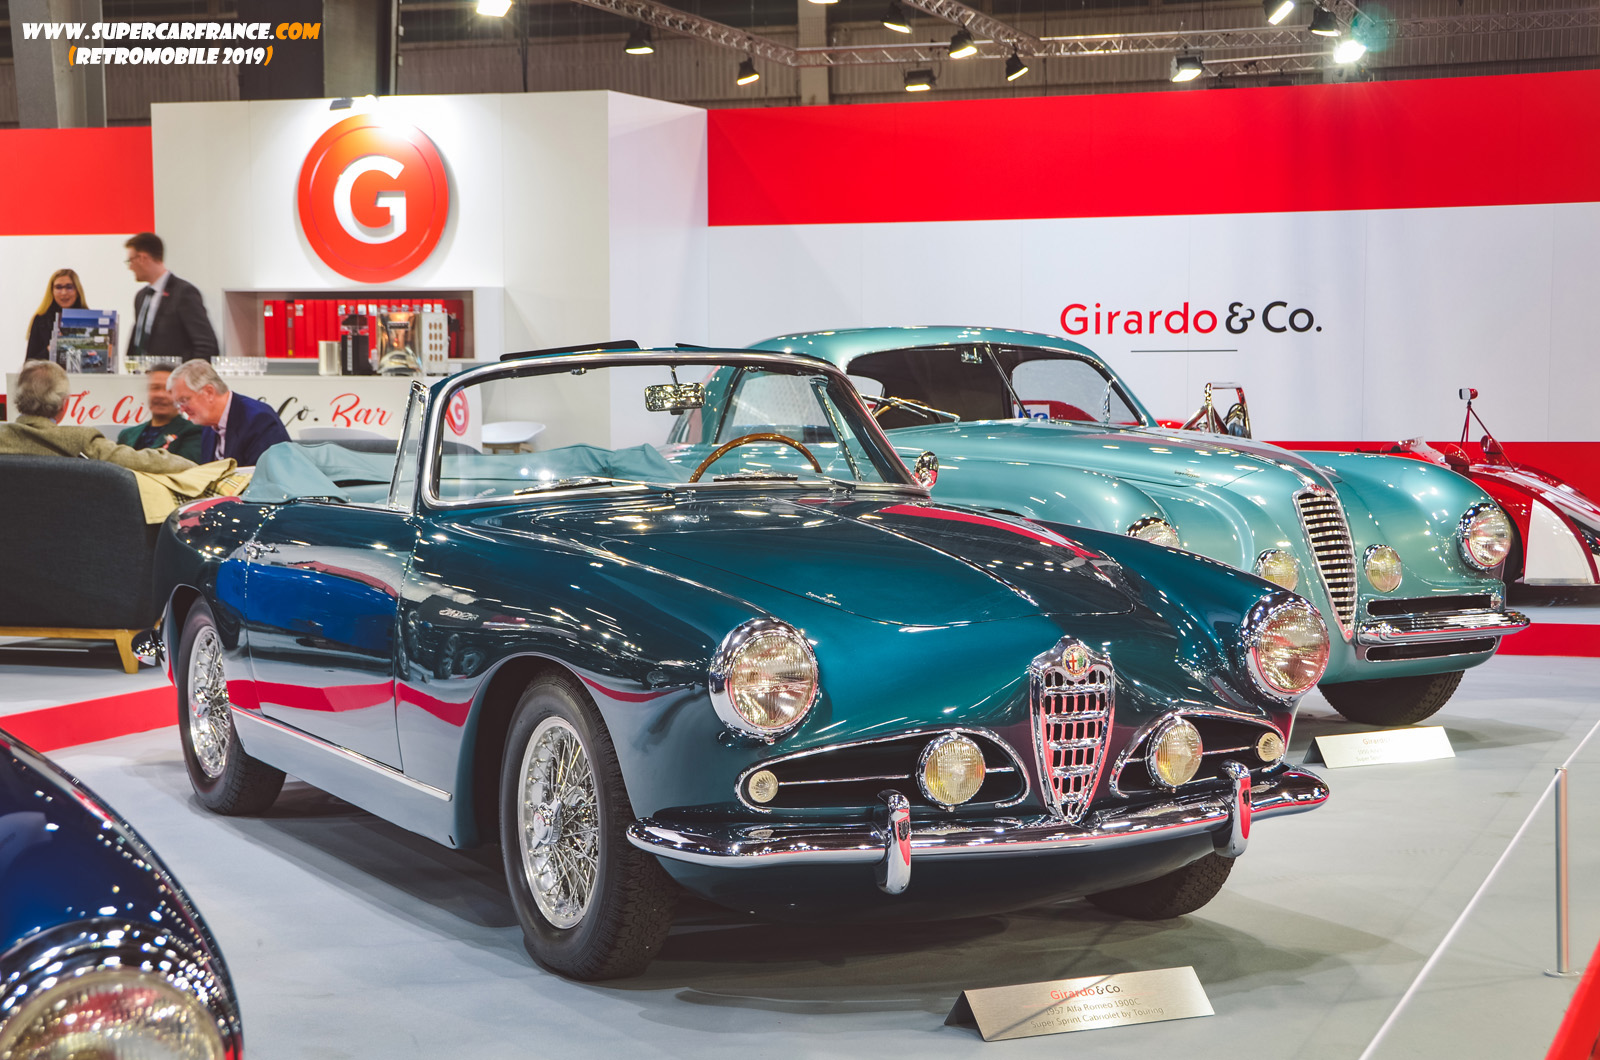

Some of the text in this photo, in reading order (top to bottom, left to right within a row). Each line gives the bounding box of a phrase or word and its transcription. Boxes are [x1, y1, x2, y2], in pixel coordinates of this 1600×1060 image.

[333, 155, 407, 245] G
[1060, 300, 1323, 335] Girardo & Co.
[329, 393, 394, 428] Bar
[1046, 998, 1141, 1015] 1957 Alfa Romeo 1900C
[1050, 984, 1124, 1000] Girardo & Co.
[1030, 1020, 1055, 1029] Super
[1056, 1016, 1082, 1026] Sprint
[1121, 1010, 1132, 1018] by
[1133, 1006, 1164, 1016] Touring
